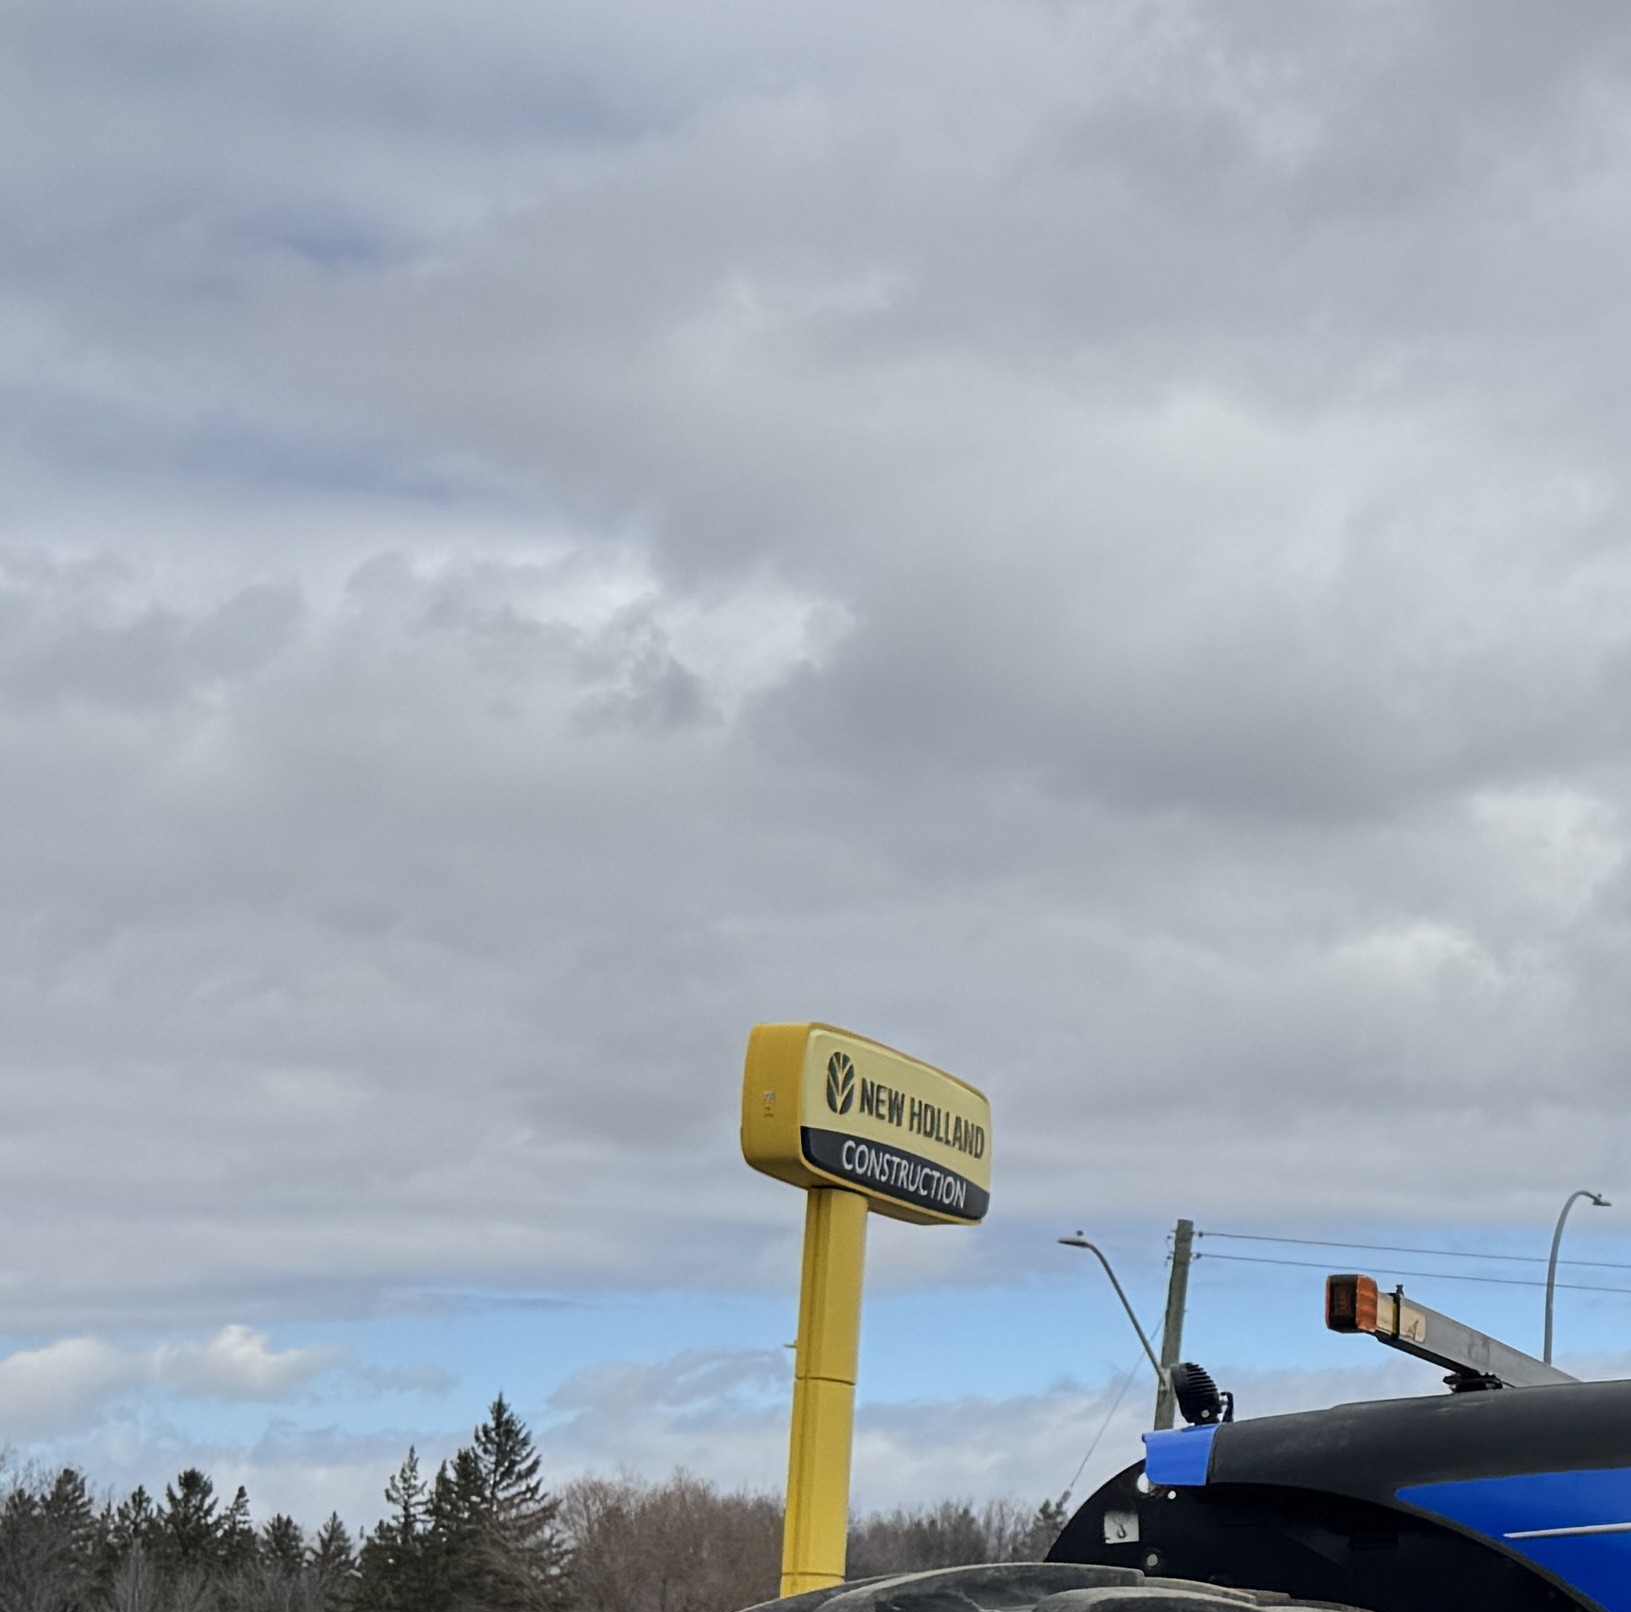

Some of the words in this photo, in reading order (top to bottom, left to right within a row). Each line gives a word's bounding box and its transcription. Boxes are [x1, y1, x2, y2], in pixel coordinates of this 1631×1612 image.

[859, 1077, 906, 1127] NEW
[908, 1096, 986, 1160] HOLLAND
[842, 1140, 967, 1209] CONSTRUCTION
